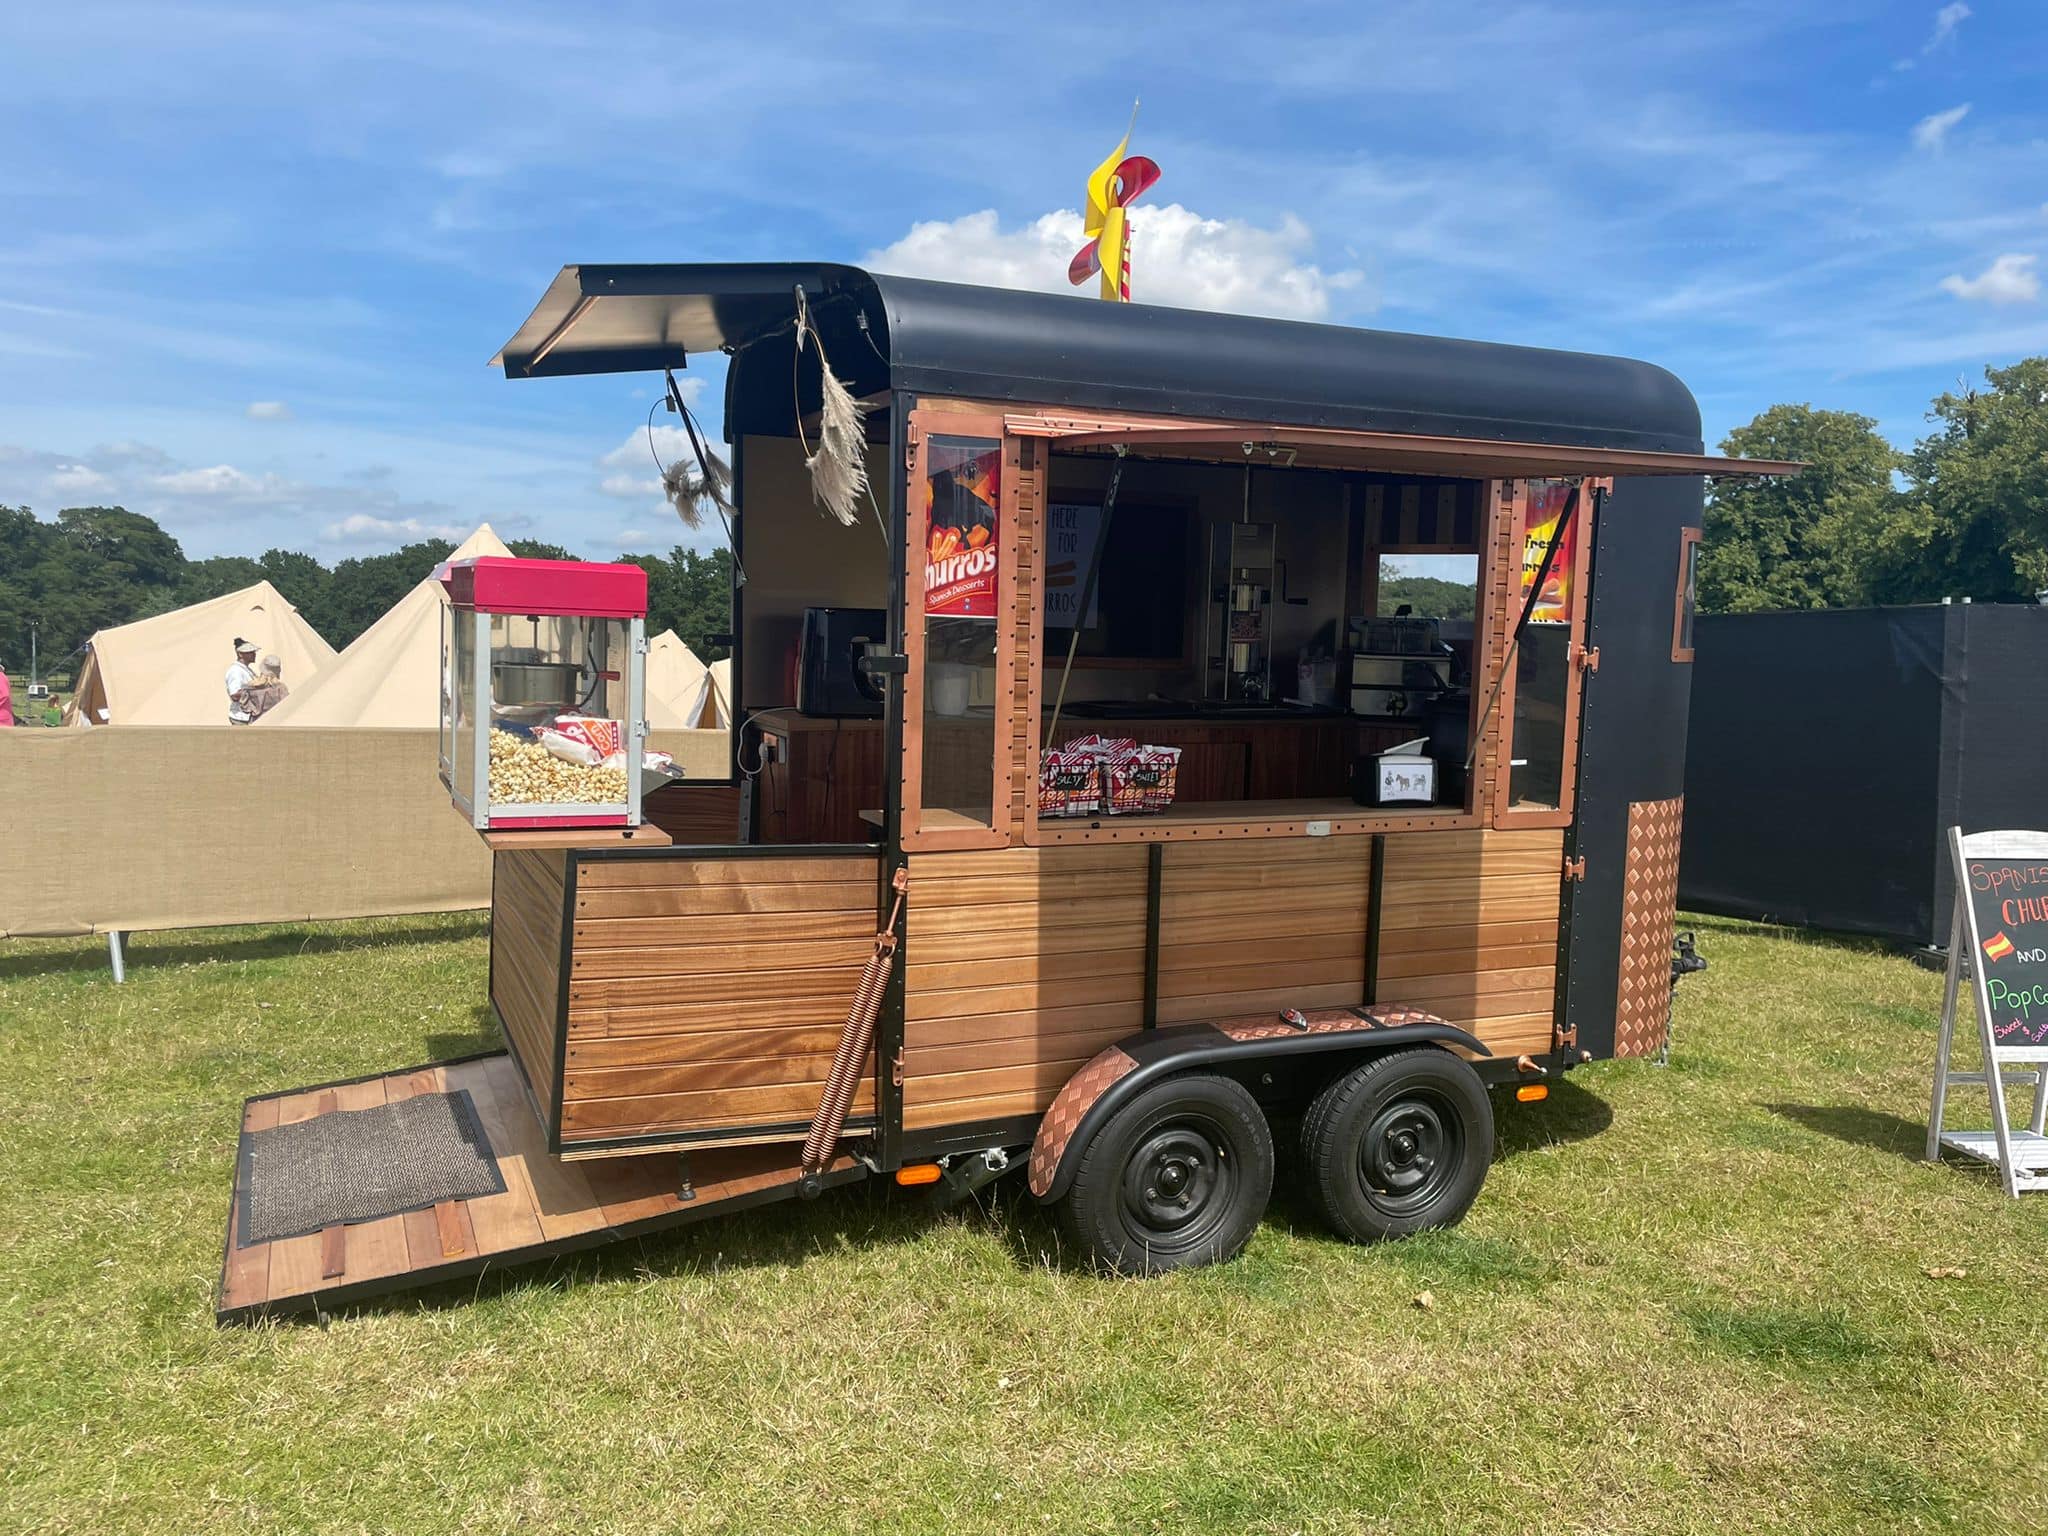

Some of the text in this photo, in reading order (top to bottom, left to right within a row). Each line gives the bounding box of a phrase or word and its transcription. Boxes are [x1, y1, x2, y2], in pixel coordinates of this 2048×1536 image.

[1052, 507, 1079, 529] HERE
[1058, 531, 1078, 553] FOR
[1057, 775, 1084, 786] SALTY
[2017, 948, 2047, 963] AND
[1994, 1017, 2023, 1039] Sweet
